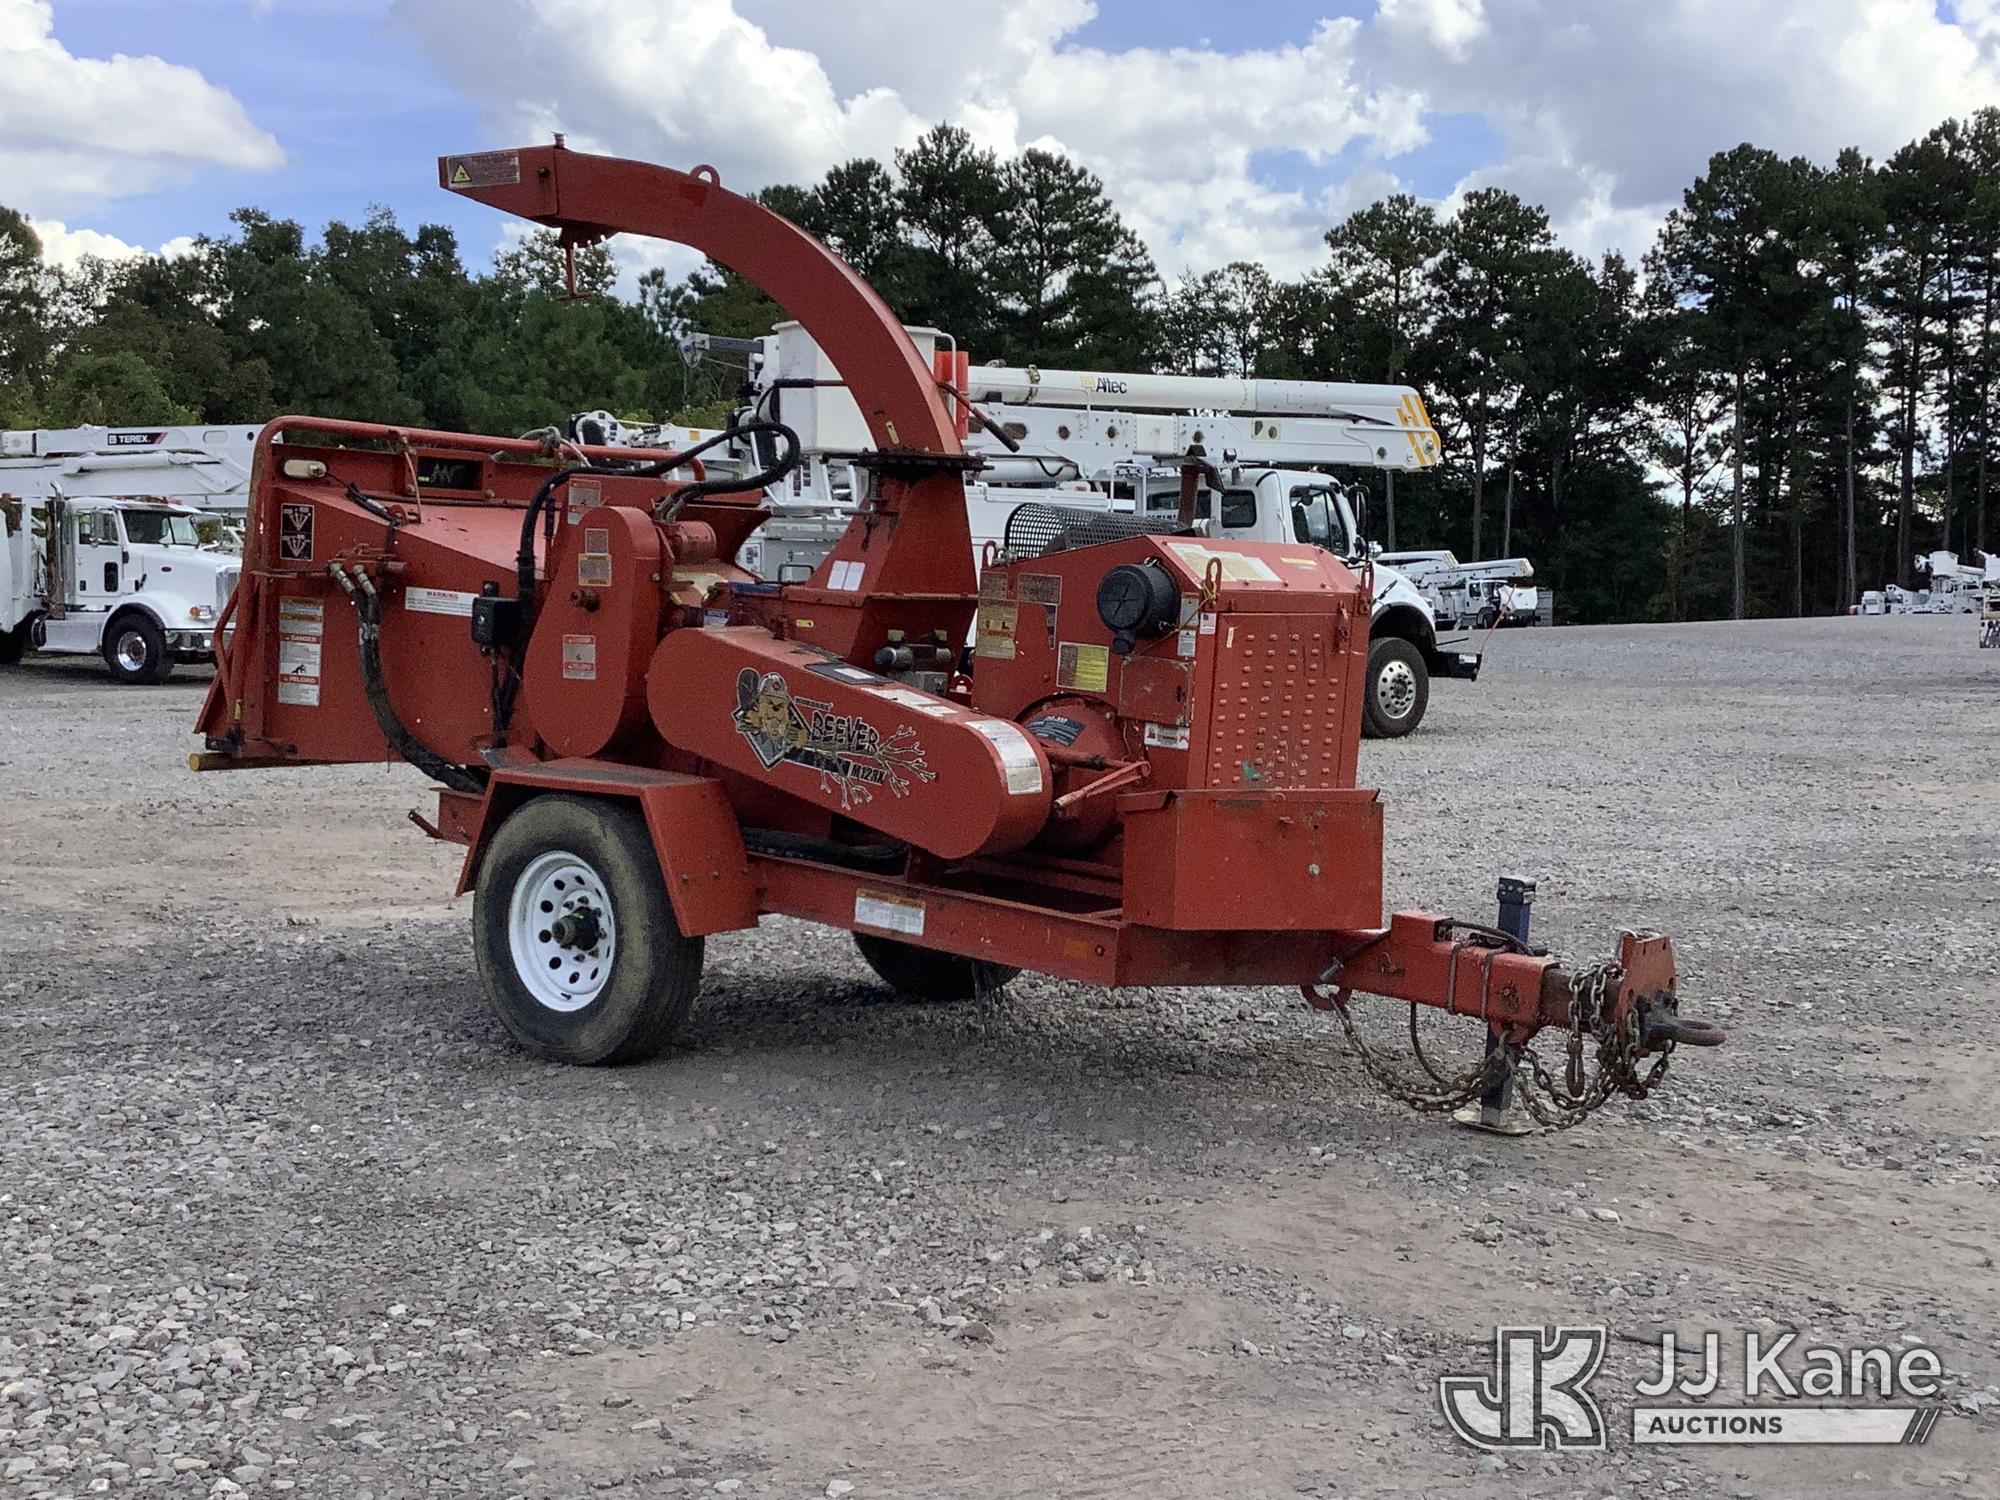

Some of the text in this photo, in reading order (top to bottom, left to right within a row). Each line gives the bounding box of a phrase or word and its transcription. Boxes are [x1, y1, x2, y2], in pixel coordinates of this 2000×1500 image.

[1096, 377, 1127, 394] Altec
[118, 434, 148, 444] TEREX
[426, 591, 459, 600] WARNING
[811, 710, 879, 754] BEEVER
